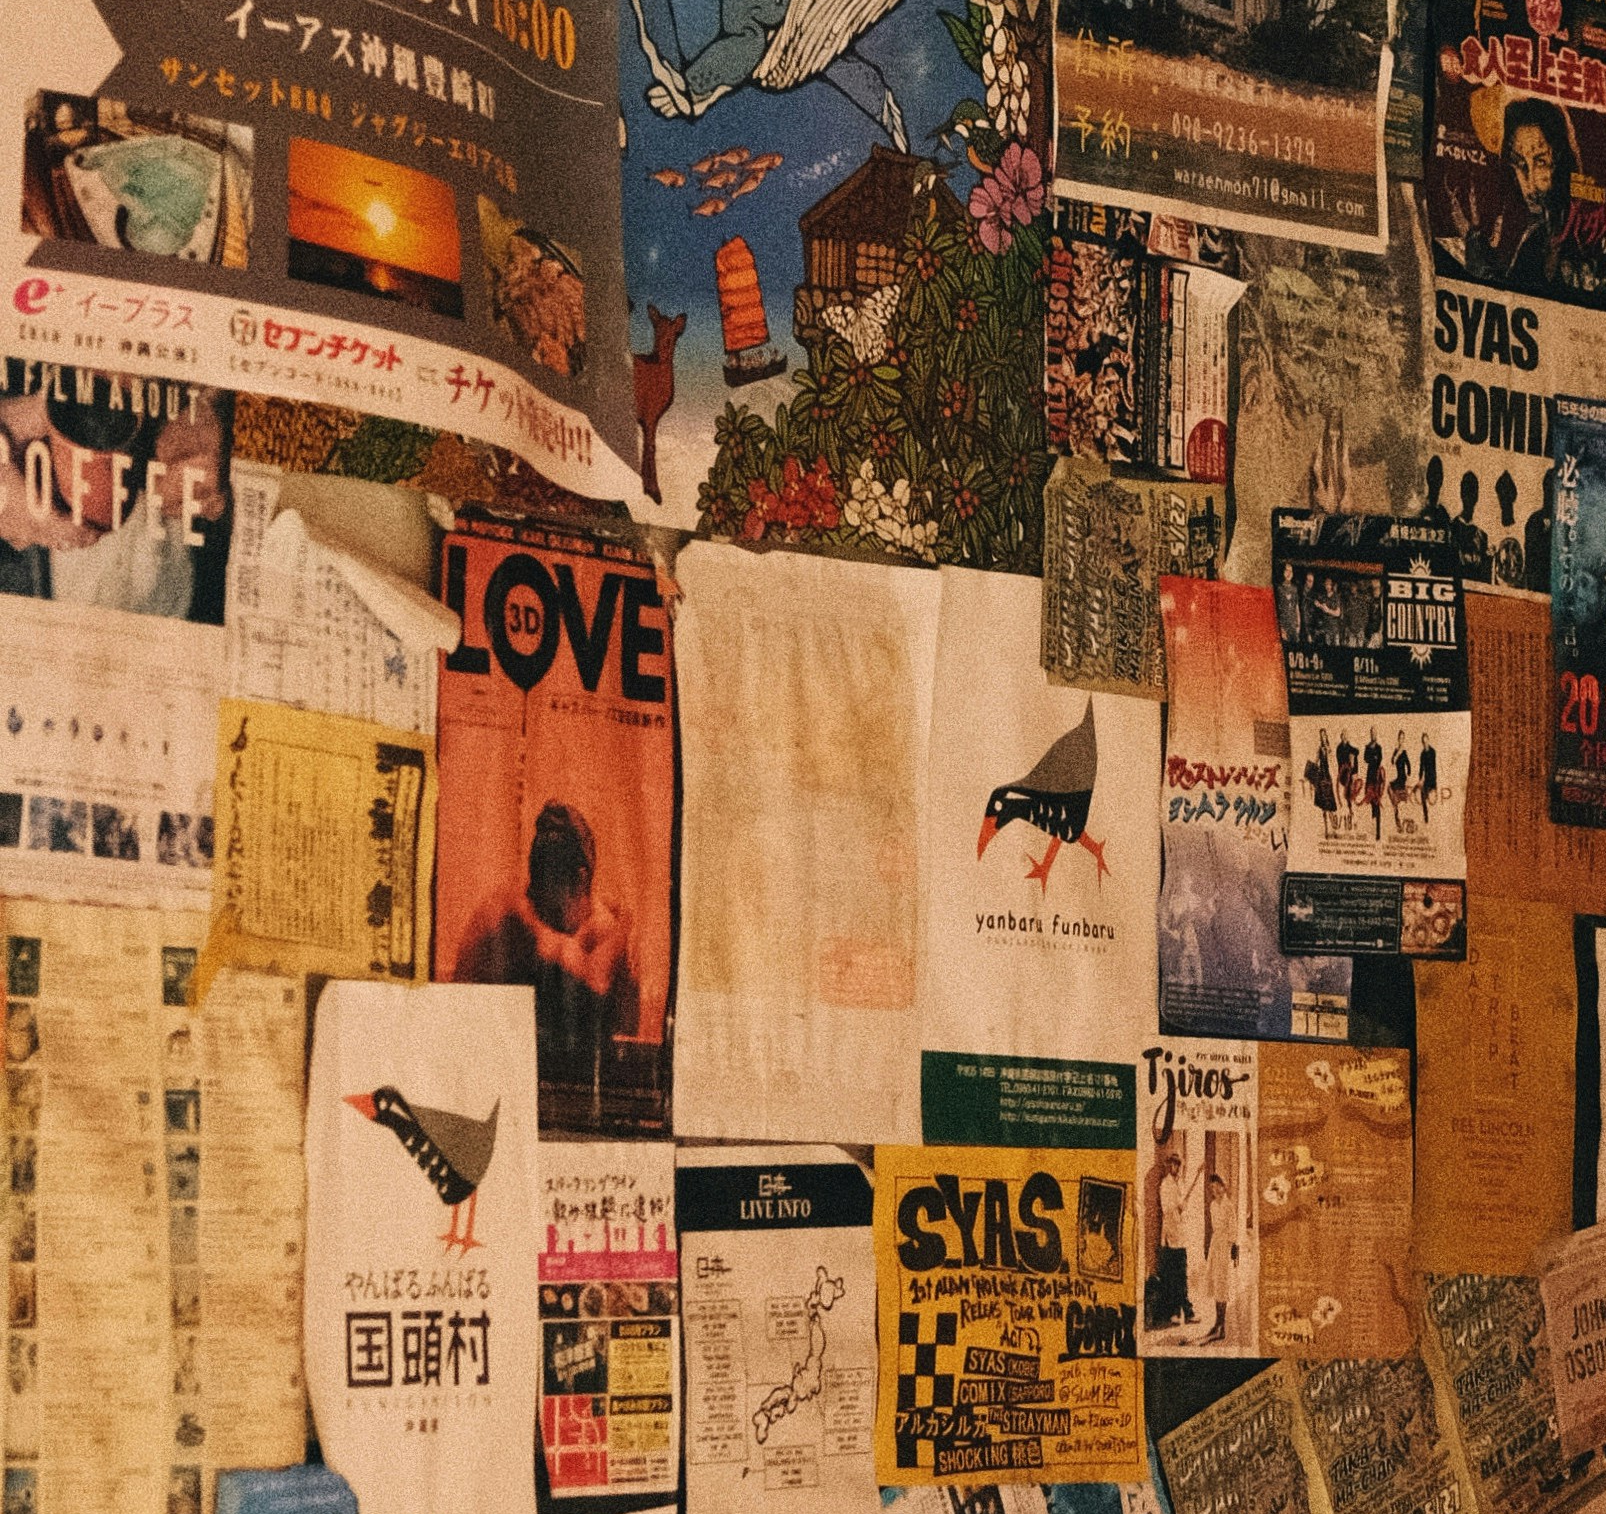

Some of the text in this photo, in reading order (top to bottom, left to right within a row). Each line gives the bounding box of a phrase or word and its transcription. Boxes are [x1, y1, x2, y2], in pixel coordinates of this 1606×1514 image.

[75, 289, 195, 331] イープラス
[1434, 289, 1539, 372] SYAS
[262, 318, 403, 372] セブンチケット
[108, 372, 203, 424] ABOUT
[0, 436, 205, 547] OFFEE
[1388, 580, 1456, 601] BIG
[444, 544, 665, 703] LOVE
[508, 602, 542, 636] 3D
[1387, 603, 1456, 644] COUNTRY
[976, 911, 1115, 941] yanbaru funbaru
[740, 1199, 812, 1221] LIVE INFO
[346, 1310, 492, 1389] 国頭村
[969, 1351, 1005, 1374] SYAS
[959, 1382, 1005, 1404] COMIX
[938, 1444, 1009, 1473] SHOCKING
